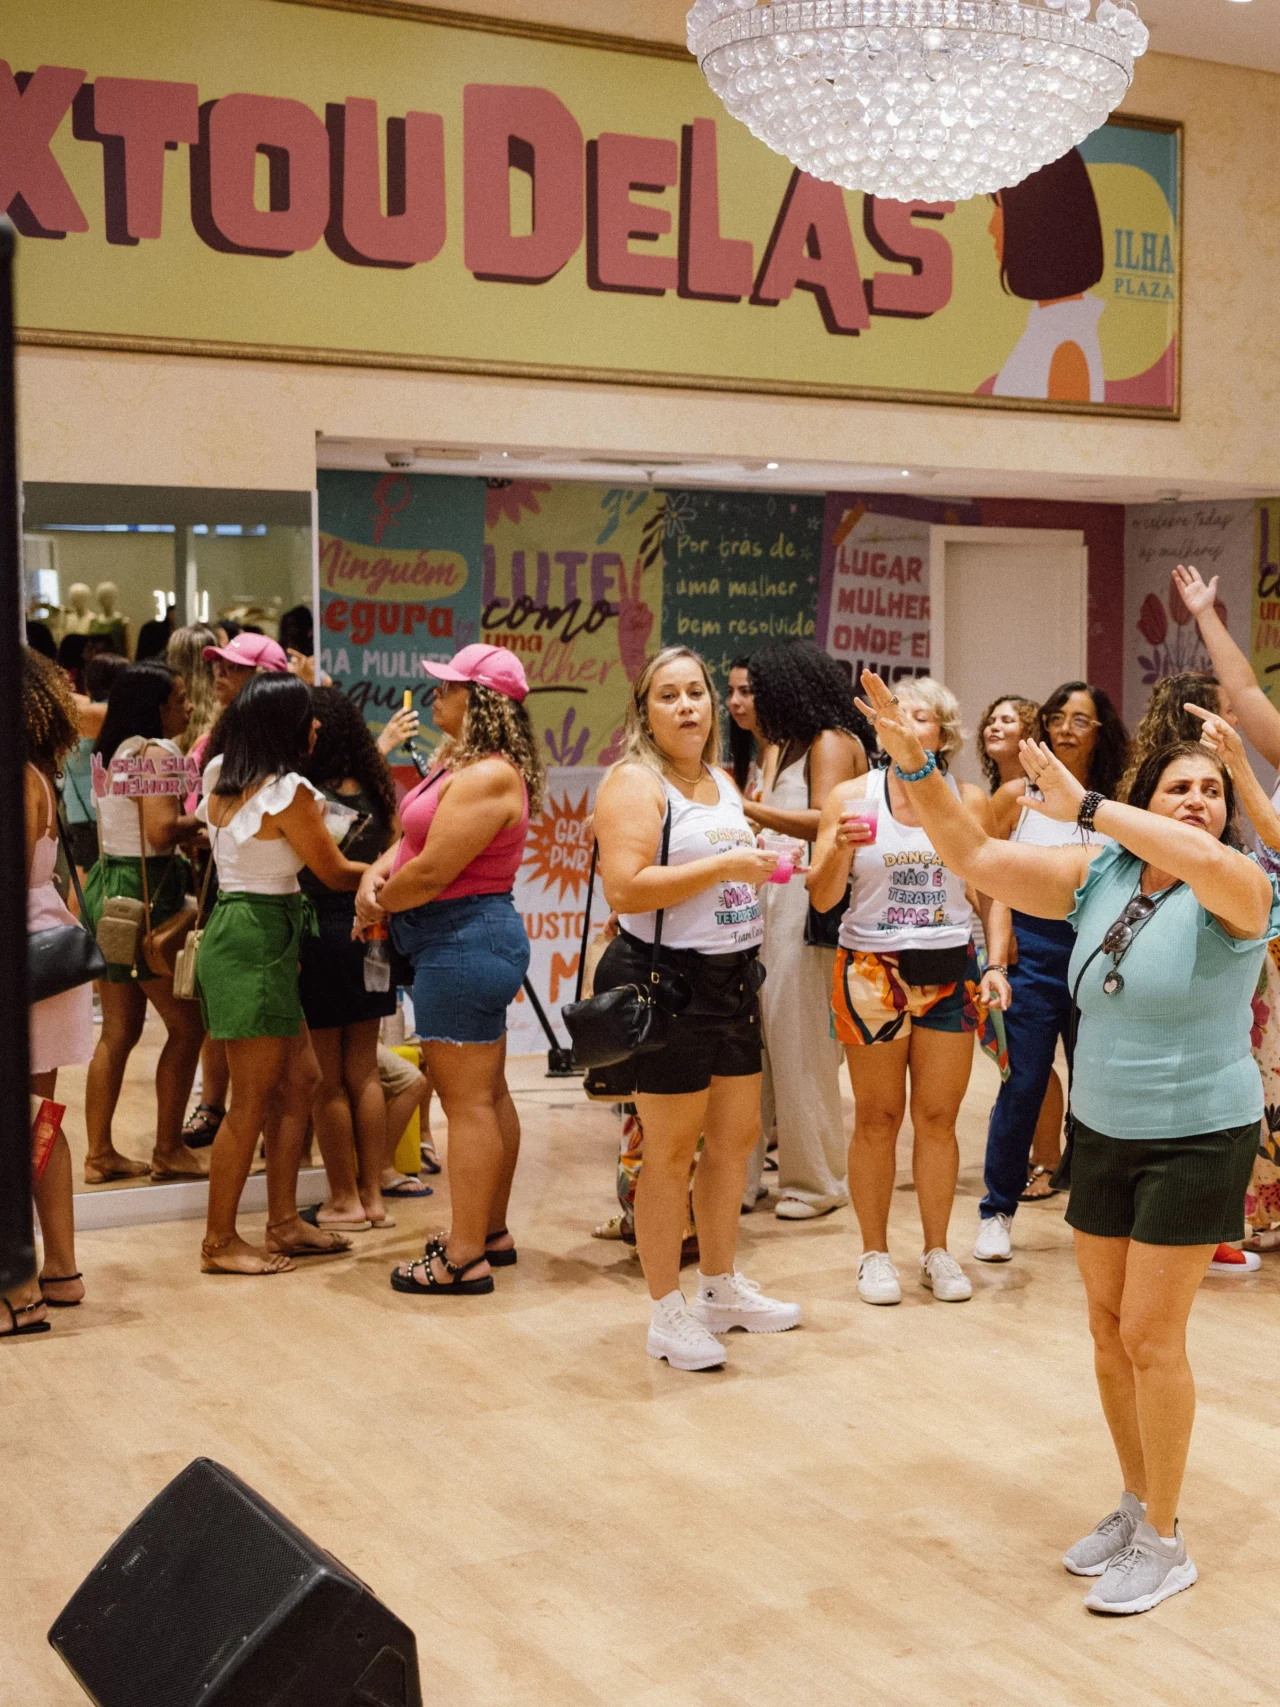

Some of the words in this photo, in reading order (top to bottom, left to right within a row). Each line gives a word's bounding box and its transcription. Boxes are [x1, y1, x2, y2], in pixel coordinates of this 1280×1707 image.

[1114, 229, 1175, 273] ILHA
[1115, 278, 1175, 298] PLAZA
[677, 534, 709, 558] Por
[770, 533, 795, 558] de
[319, 537, 458, 595] Ninguém
[483, 544, 621, 611] LUTE
[838, 545, 922, 584] LUGAR
[677, 578, 720, 597] uma
[728, 574, 797, 598] mulher
[320, 598, 453, 646] egura
[482, 595, 619, 643] como
[678, 609, 720, 637] bem
[728, 611, 815, 637] resolvida
[834, 623, 901, 656] ONDE
[320, 648, 350, 675] MA
[525, 637, 620, 685] ulher
[111, 757, 157, 775] SEJA
[160, 757, 199, 774] SUA
[111, 778, 181, 796] MELHOR
[883, 851, 947, 869] DANÇA
[893, 868, 928, 886] NÃO
[932, 868, 942, 887] É
[724, 884, 751, 908] MAS
[888, 887, 946, 904] TERAPIA
[888, 907, 929, 926] MAS
